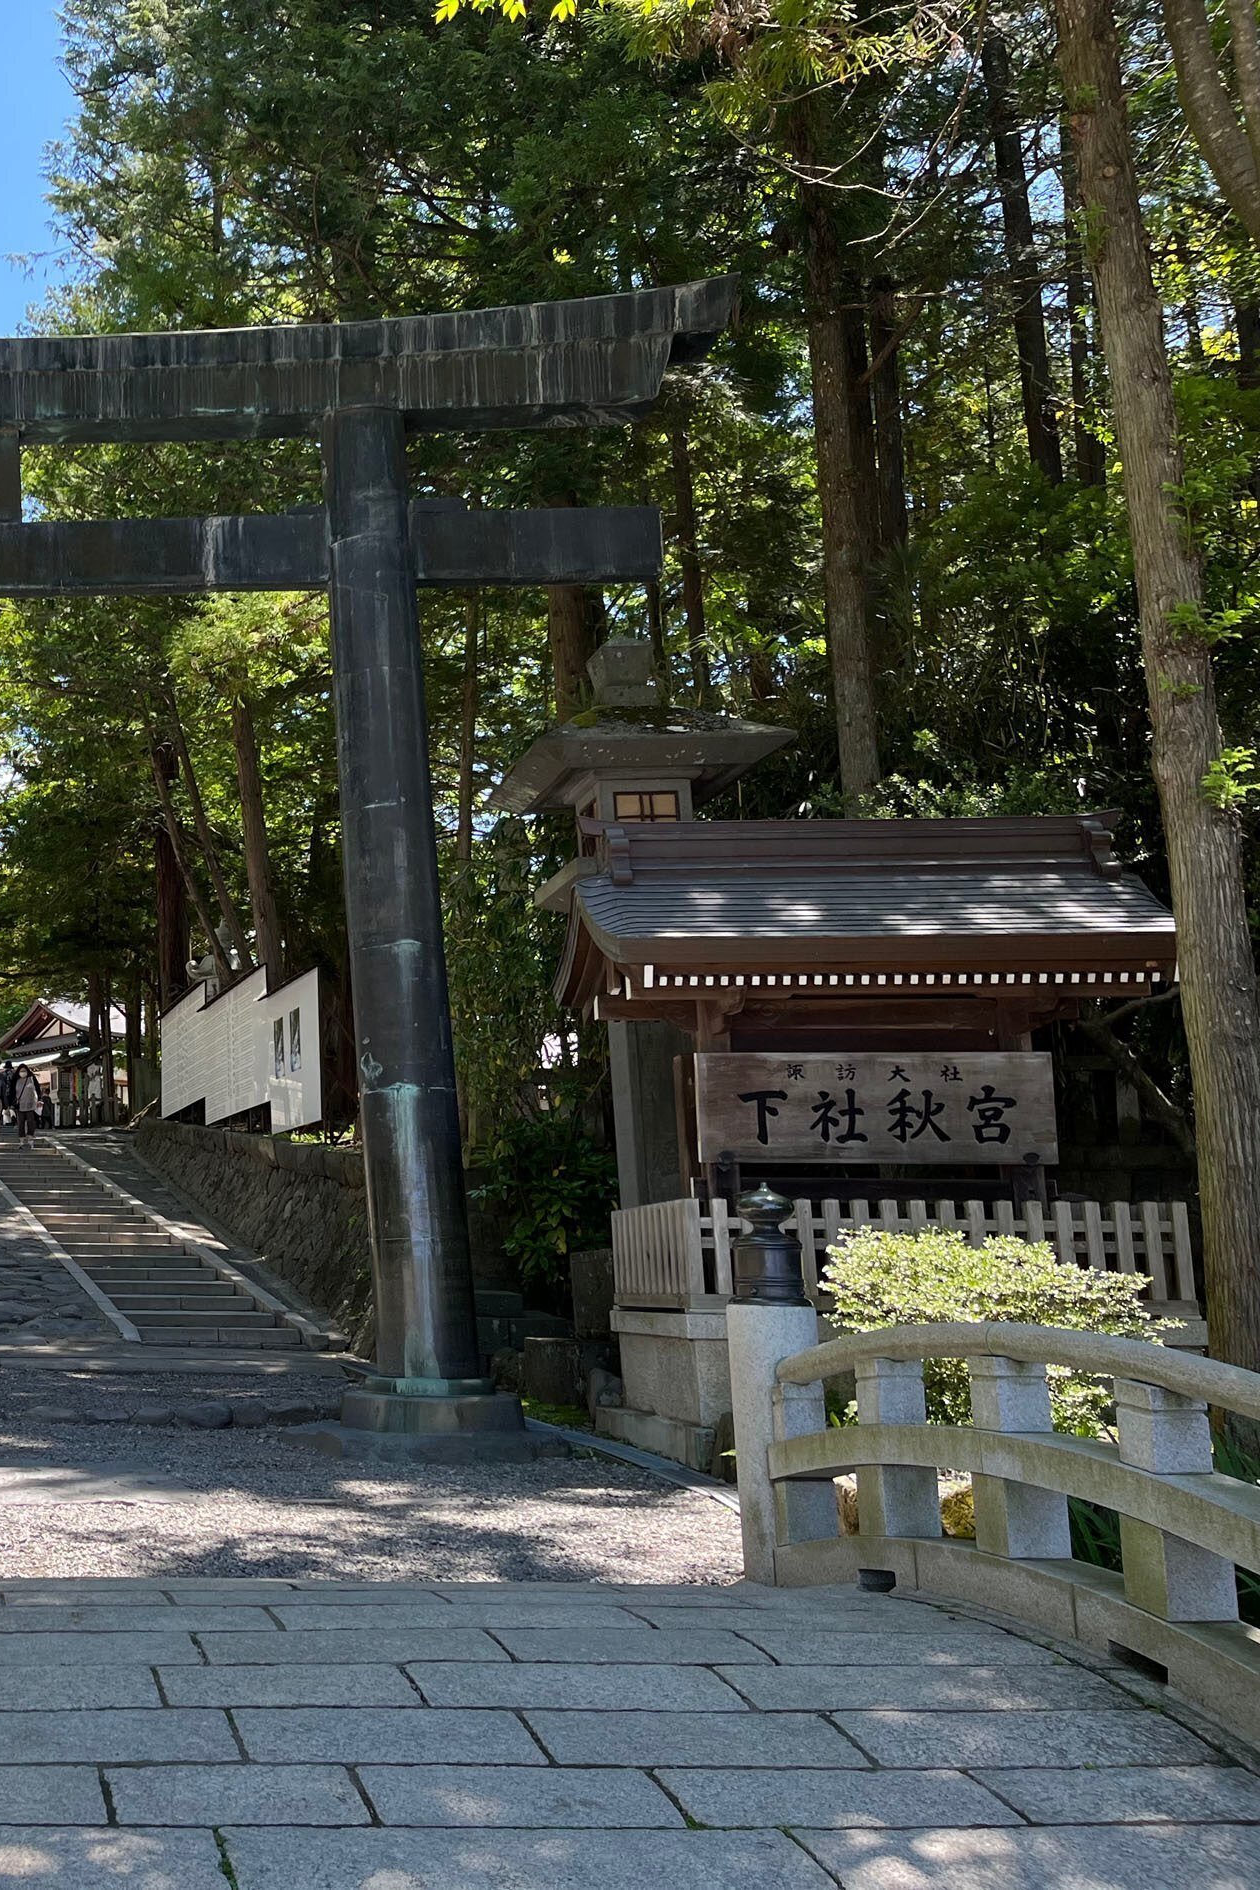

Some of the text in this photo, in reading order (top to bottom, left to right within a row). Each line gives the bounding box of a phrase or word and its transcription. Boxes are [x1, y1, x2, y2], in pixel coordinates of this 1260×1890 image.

[787, 1064, 963, 1082] 諏訪大社
[738, 1085, 1018, 1145] 下社秋宮
